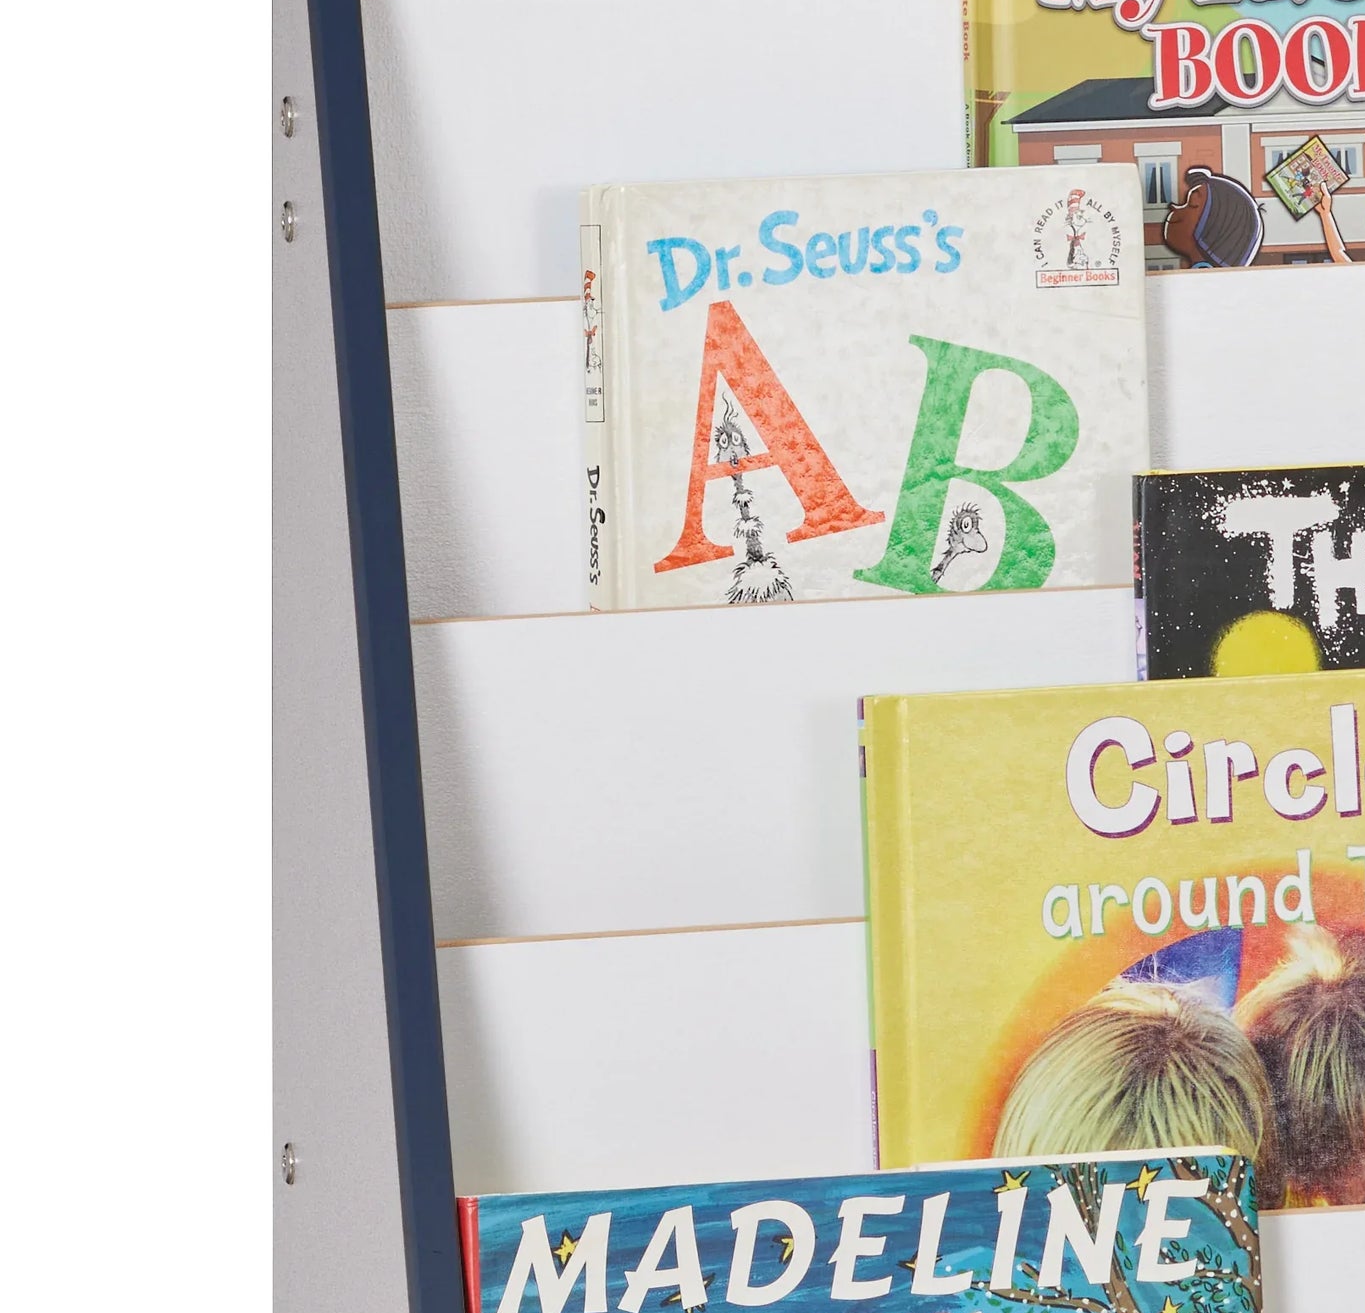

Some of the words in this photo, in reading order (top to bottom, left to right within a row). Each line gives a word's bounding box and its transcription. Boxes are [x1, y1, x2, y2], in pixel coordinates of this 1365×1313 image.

[1054, 200, 1064, 210] IT
[1086, 198, 1103, 212] ALL
[1034, 208, 1054, 233] READ
[1103, 211, 1115, 223] BY
[1033, 239, 1045, 260] CAN
[1109, 226, 1121, 266] MYSELF
[646, 237, 754, 312] Dr.
[757, 208, 965, 287] Seuss's
[1040, 273, 1083, 285] Beginner
[1085, 271, 1116, 281] Books
[589, 507, 606, 586] Seuss's
[1041, 847, 1318, 939] around
